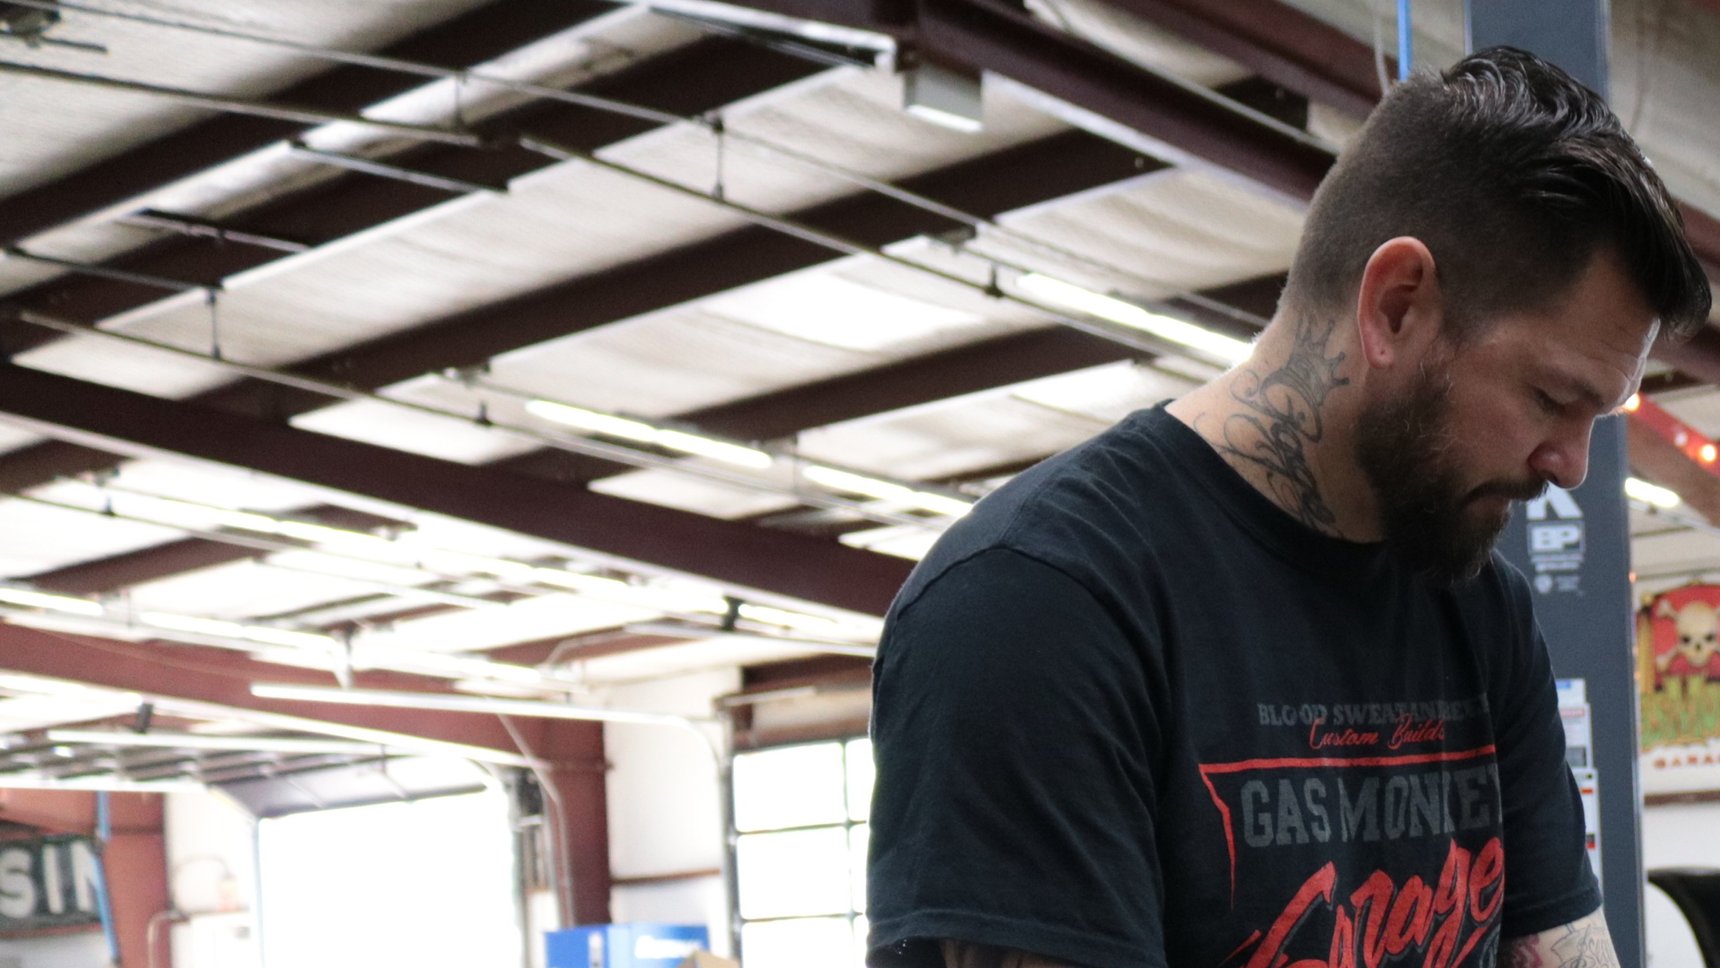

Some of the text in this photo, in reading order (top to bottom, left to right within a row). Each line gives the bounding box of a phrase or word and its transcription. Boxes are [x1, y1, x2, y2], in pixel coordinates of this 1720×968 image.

[1257, 703, 1328, 726] BLOOD
[1309, 712, 1446, 751] Custom Builds
[1241, 777, 1332, 848] GAS
